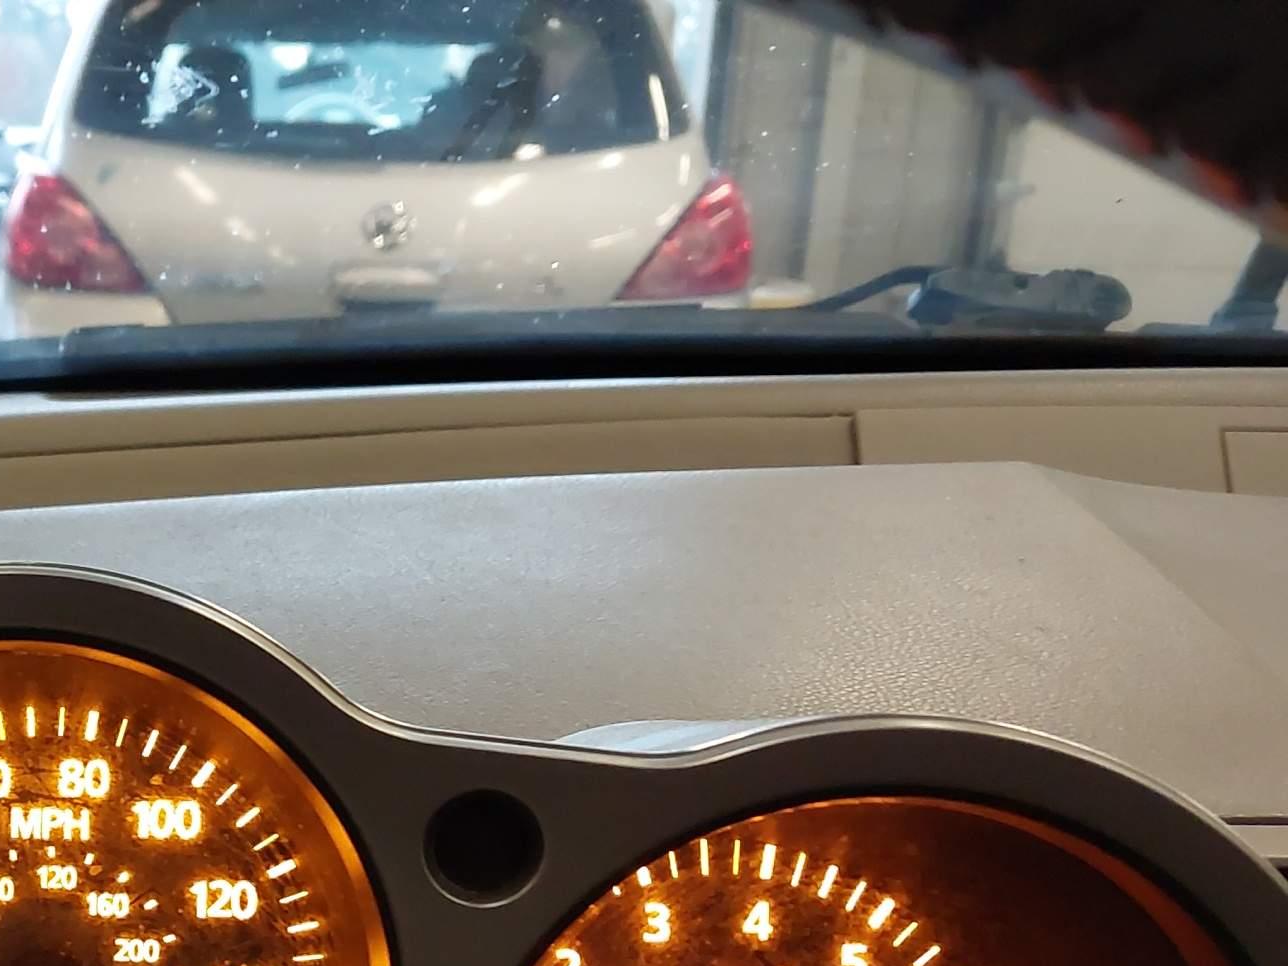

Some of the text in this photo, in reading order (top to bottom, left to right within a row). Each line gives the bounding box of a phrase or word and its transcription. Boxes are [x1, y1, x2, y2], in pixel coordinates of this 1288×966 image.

[57, 758, 111, 799] 80
[10, 806, 91, 841] MPH
[130, 799, 203, 841] 100
[36, 865, 78, 891] 120
[86, 892, 130, 918] 160
[188, 879, 259, 921] 120
[742, 900, 774, 941] 4
[642, 901, 672, 943] 3
[113, 937, 161, 964] 200
